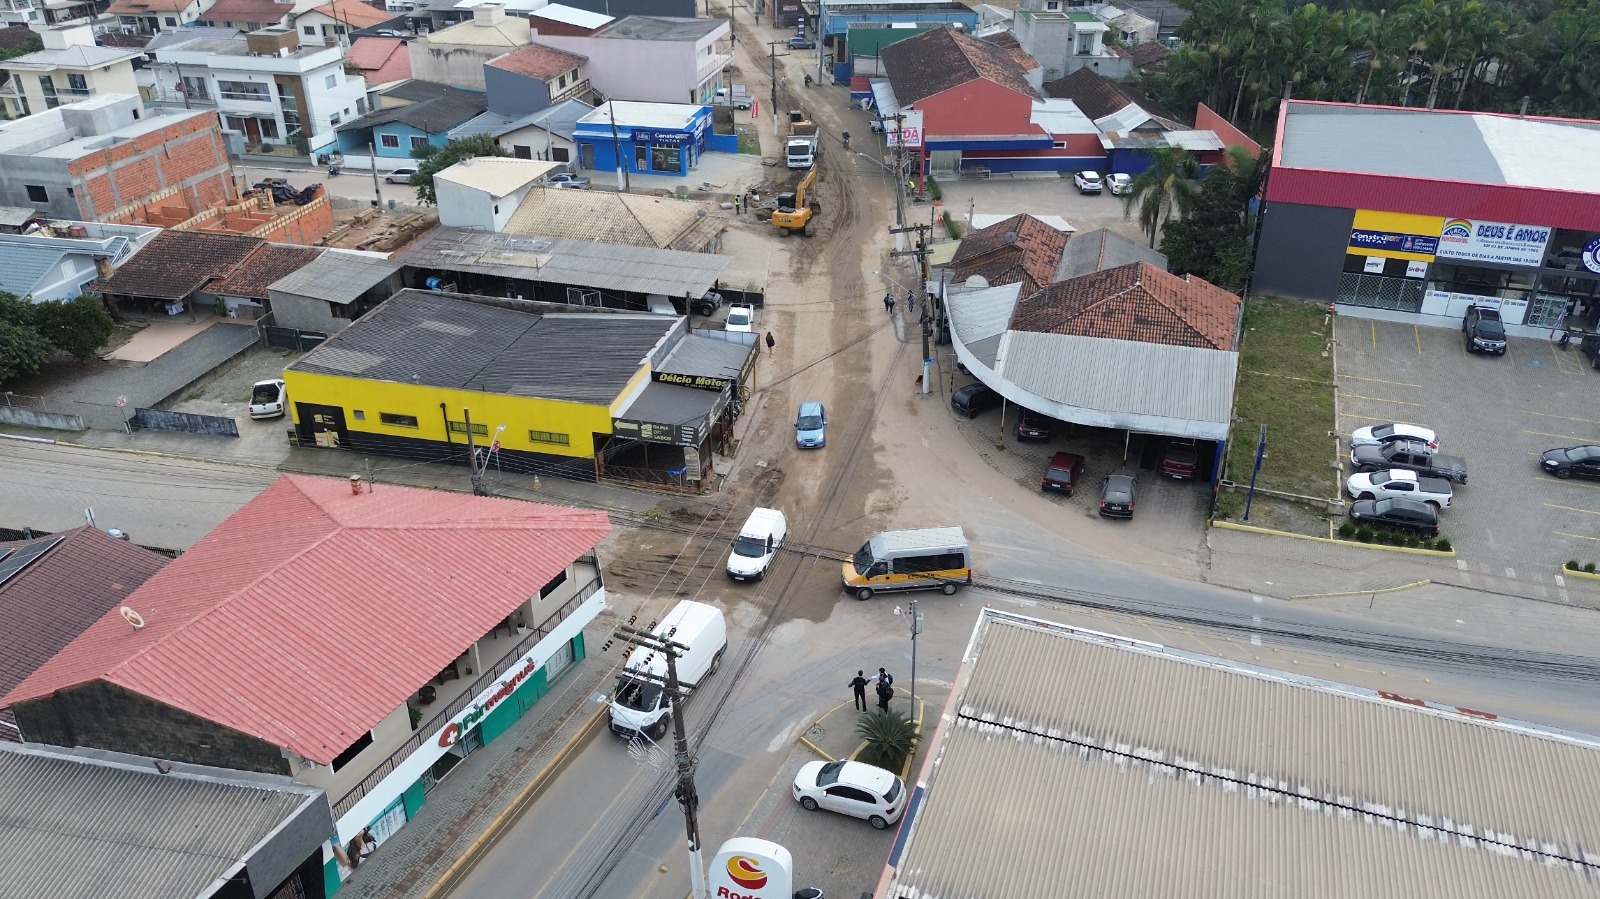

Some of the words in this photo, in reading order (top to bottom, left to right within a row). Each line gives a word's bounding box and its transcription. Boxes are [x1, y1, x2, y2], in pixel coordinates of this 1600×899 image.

[891, 129, 919, 139] VDA
[1477, 225, 1505, 239] DEUS
[1505, 224, 1515, 241] É
[1514, 227, 1549, 244] AMOR
[659, 373, 692, 384] Délcio
[695, 376, 728, 388] Motos
